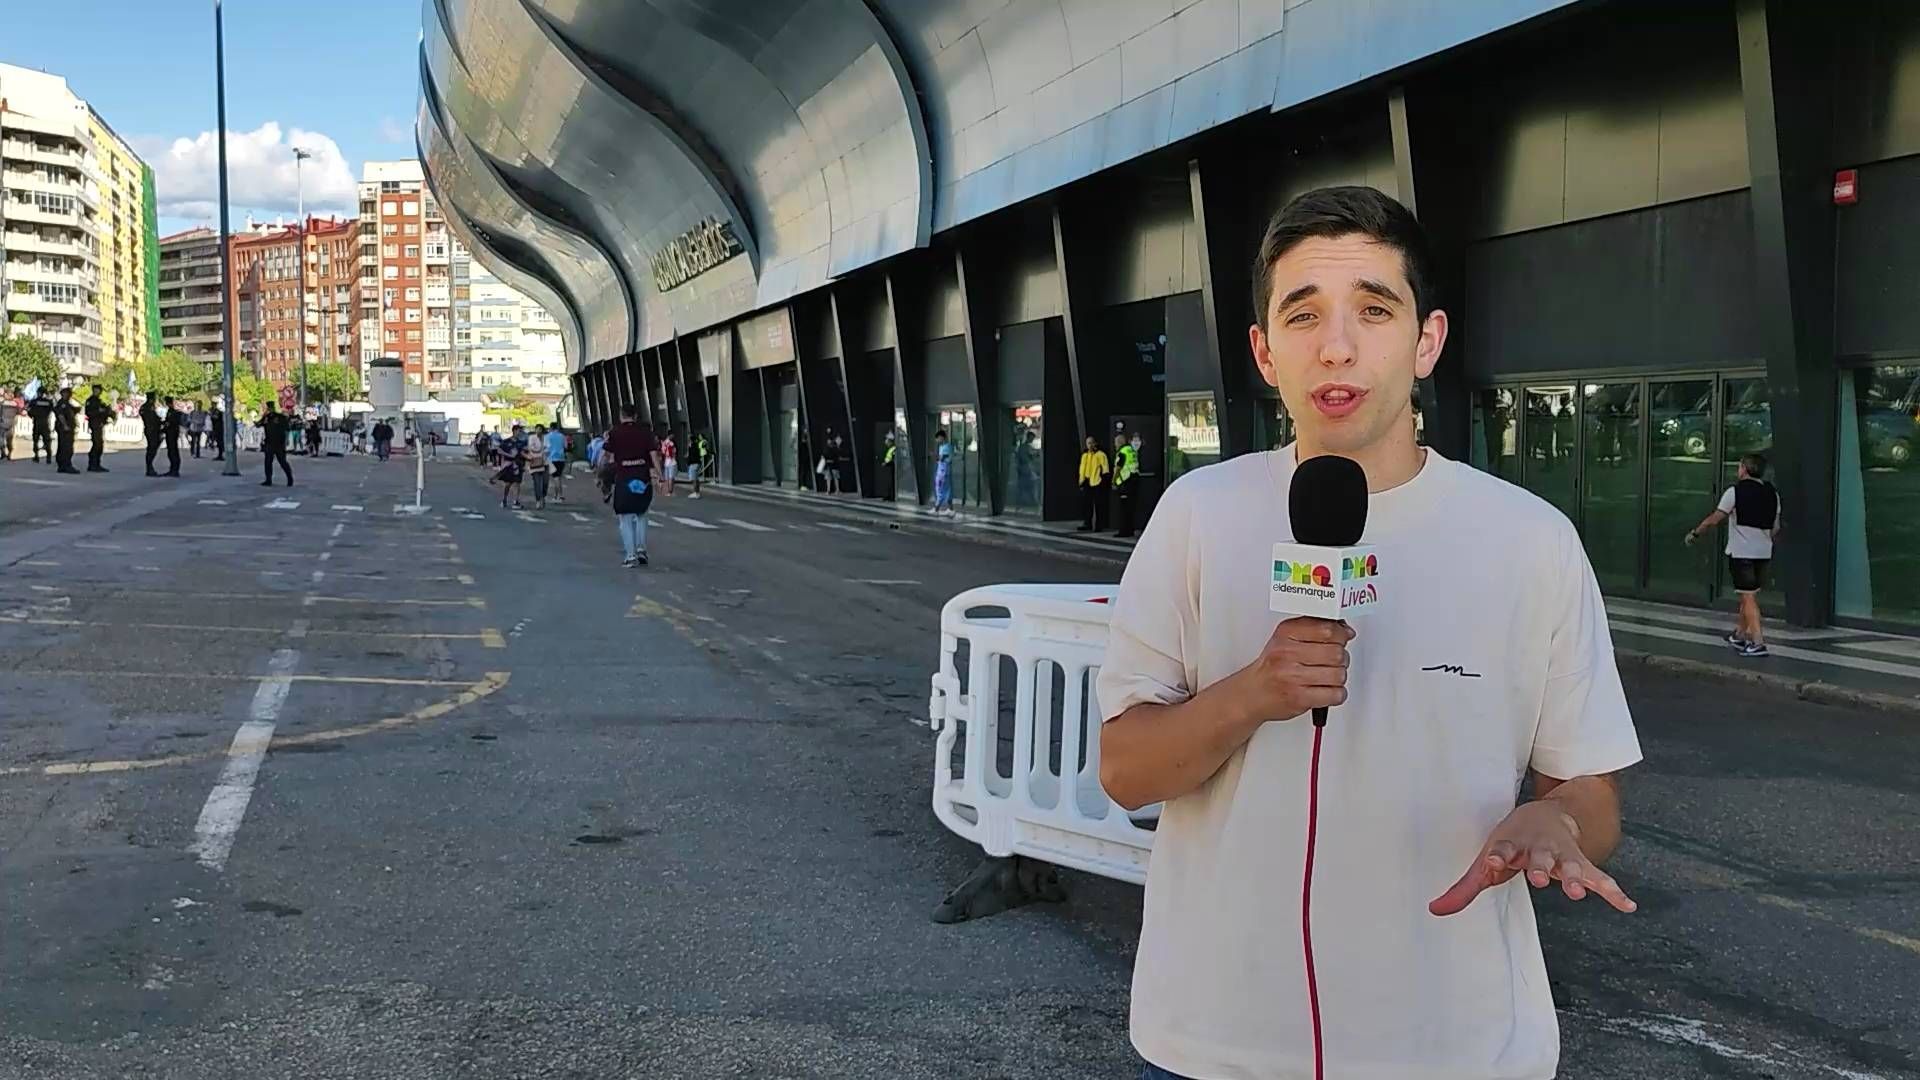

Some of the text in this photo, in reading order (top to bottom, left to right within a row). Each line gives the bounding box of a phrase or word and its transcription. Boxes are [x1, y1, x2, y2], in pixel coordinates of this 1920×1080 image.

[1274, 560, 1333, 587] DMQ
[1273, 584, 1335, 600] eldesmarque
[1341, 585, 1366, 608] Live
